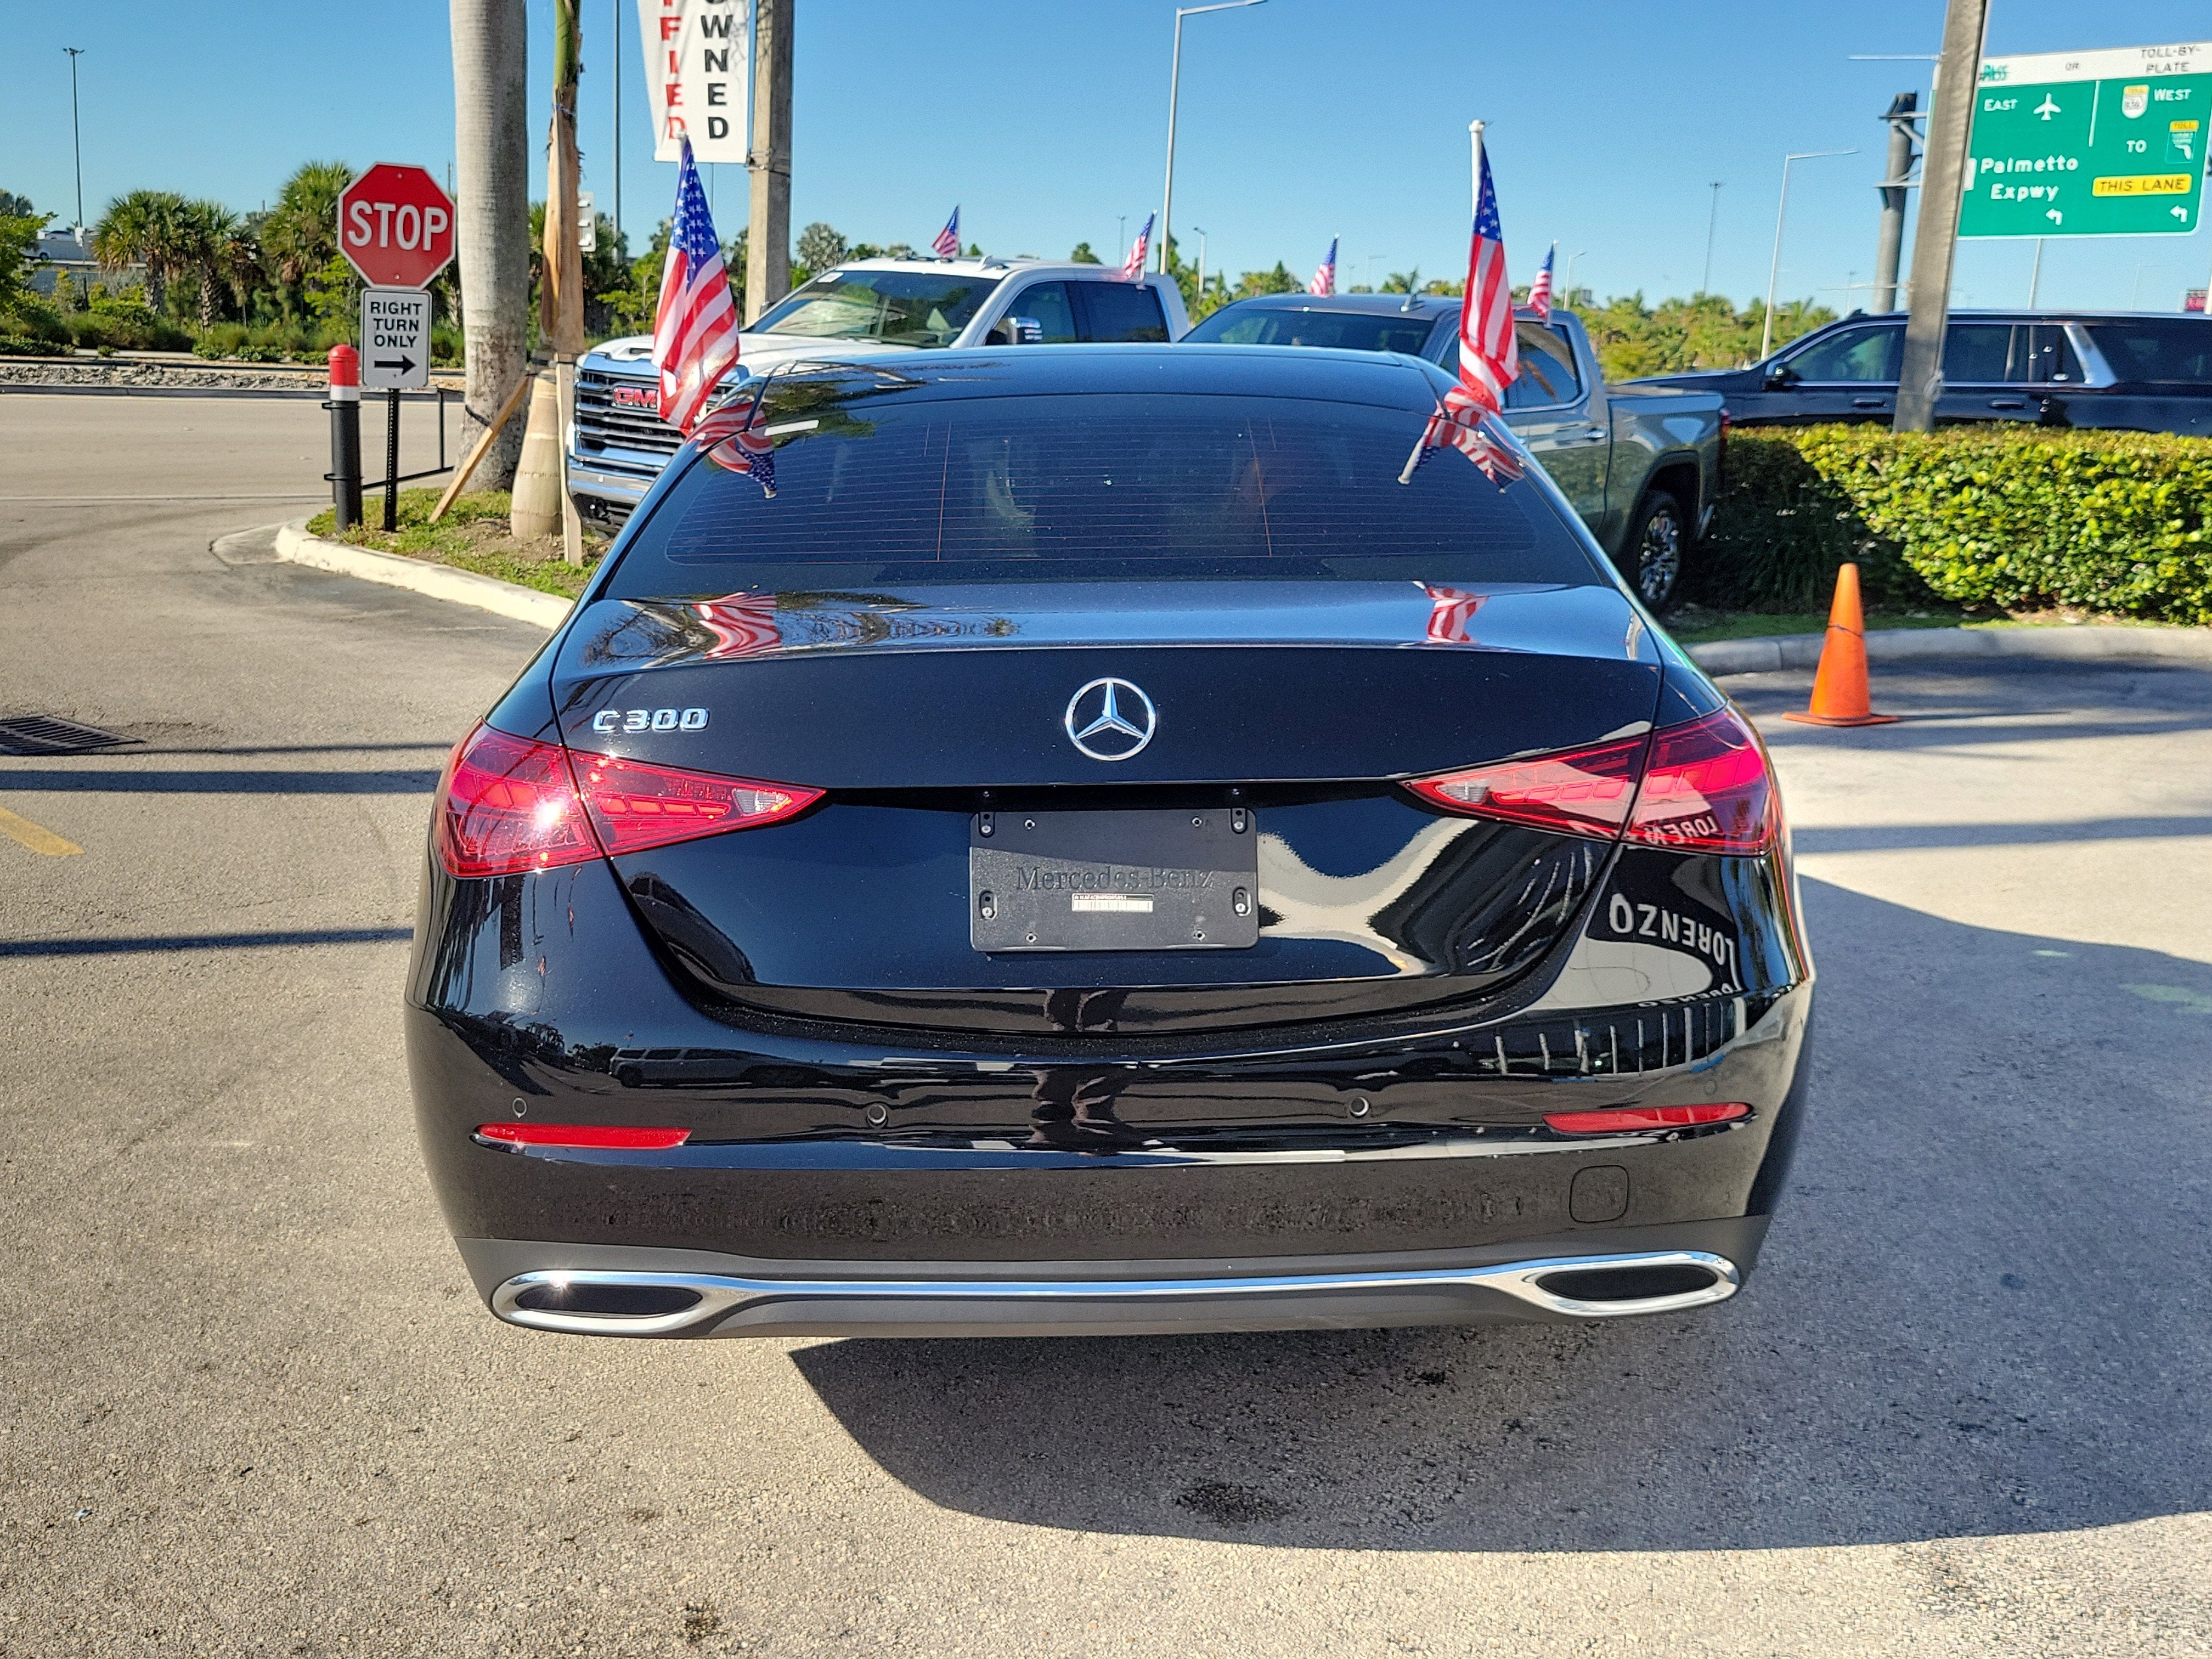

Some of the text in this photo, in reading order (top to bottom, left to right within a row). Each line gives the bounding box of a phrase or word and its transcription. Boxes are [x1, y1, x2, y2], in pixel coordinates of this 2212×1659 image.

[659, 0, 686, 139] FIED
[701, 0, 733, 139] WNED
[2146, 62, 2190, 74] PLATE
[2154, 88, 2192, 101] WEST
[1984, 99, 2018, 111] EAST
[2126, 140, 2147, 153] TO
[1980, 155, 2079, 174] Palmetto
[1990, 183, 2059, 202] Expwy
[2100, 179, 2185, 192] THIS LANE
[348, 199, 448, 251] STOP
[370, 301, 422, 315] RIGHT
[374, 318, 419, 332] TURN
[374, 335, 417, 348] ONLY
[614, 386, 658, 409] GM
